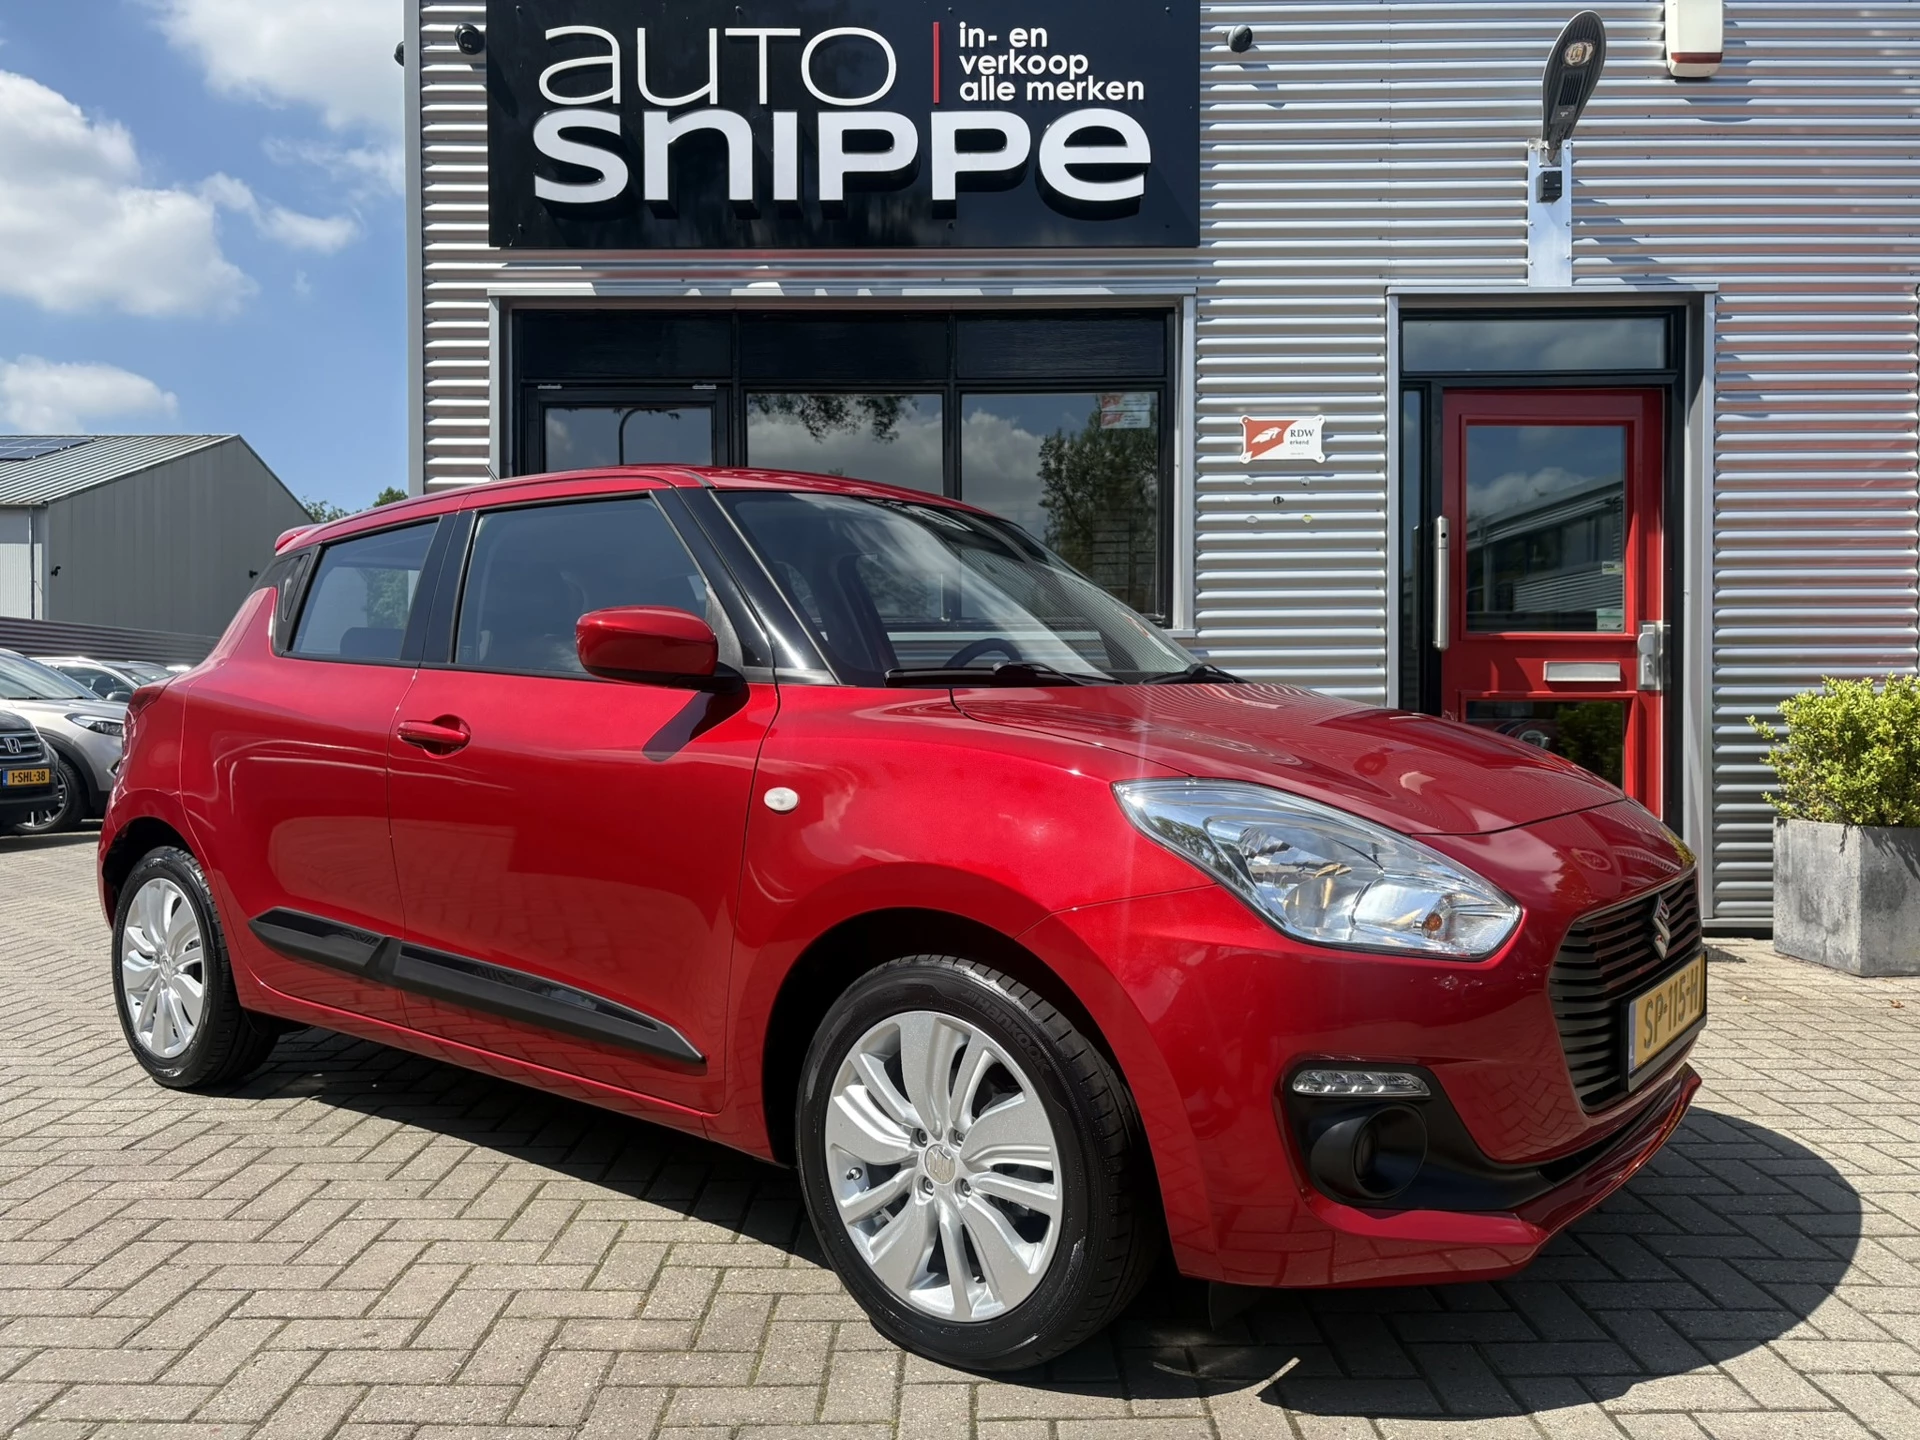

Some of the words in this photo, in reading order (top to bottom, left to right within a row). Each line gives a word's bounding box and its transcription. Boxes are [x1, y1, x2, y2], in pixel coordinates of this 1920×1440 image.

[959, 21, 998, 48] in-
[1008, 27, 1048, 48] en
[958, 48, 1089, 81] verkoop
[959, 75, 1016, 101] alle
[1026, 75, 1145, 101] merken
[1290, 429, 1315, 438] RDW
[11, 770, 46, 783] 1-SHL-38
[1644, 964, 1699, 1049] SP-115-H
